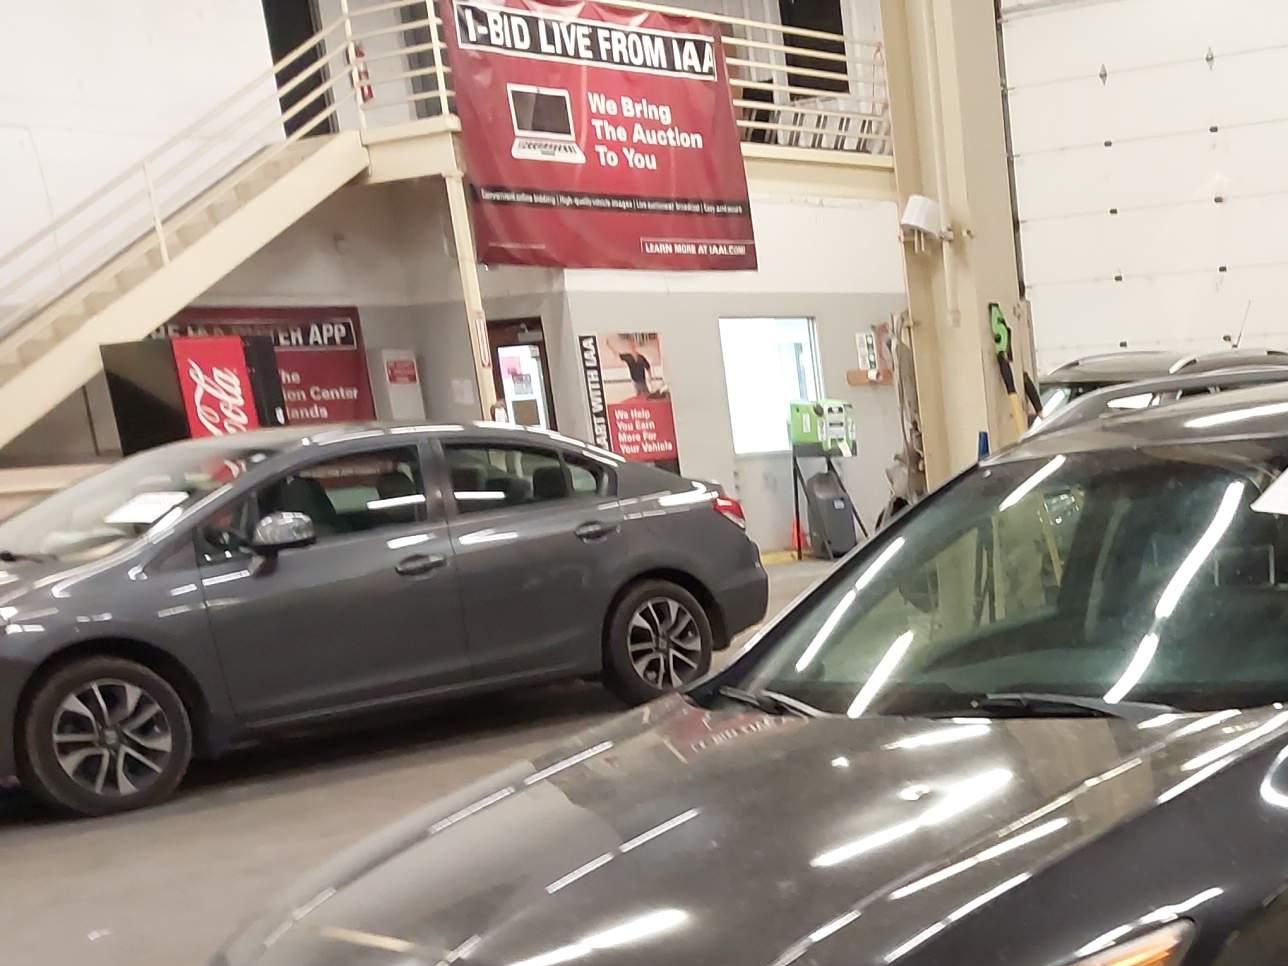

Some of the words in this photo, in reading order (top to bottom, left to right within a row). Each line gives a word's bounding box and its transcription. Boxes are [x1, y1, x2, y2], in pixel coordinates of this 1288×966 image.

[464, 8, 531, 49] I-BID
[538, 18, 593, 58] LIVE
[597, 28, 667, 69] FROM
[672, 39, 714, 72] IAA
[588, 91, 617, 116] We
[621, 95, 671, 125] Bring
[591, 118, 627, 142] The
[633, 123, 703, 148] Auction
[595, 144, 618, 167] To
[622, 146, 657, 170] You
[645, 242, 672, 254] LEARN
[674, 243, 696, 254] MORE
[698, 244, 708, 255] AT
[309, 323, 346, 346] APP
[582, 337, 597, 367] IAA
[279, 368, 300, 385] he
[310, 385, 358, 401] Center
[587, 369, 603, 414] WITH
[615, 408, 629, 420] We
[631, 408, 650, 420] Help
[617, 420, 633, 431] You
[635, 420, 655, 431] Earn
[618, 431, 641, 442] More
[643, 431, 656, 441] For
[620, 443, 639, 454] Your
[641, 441, 672, 453] Vehicle
